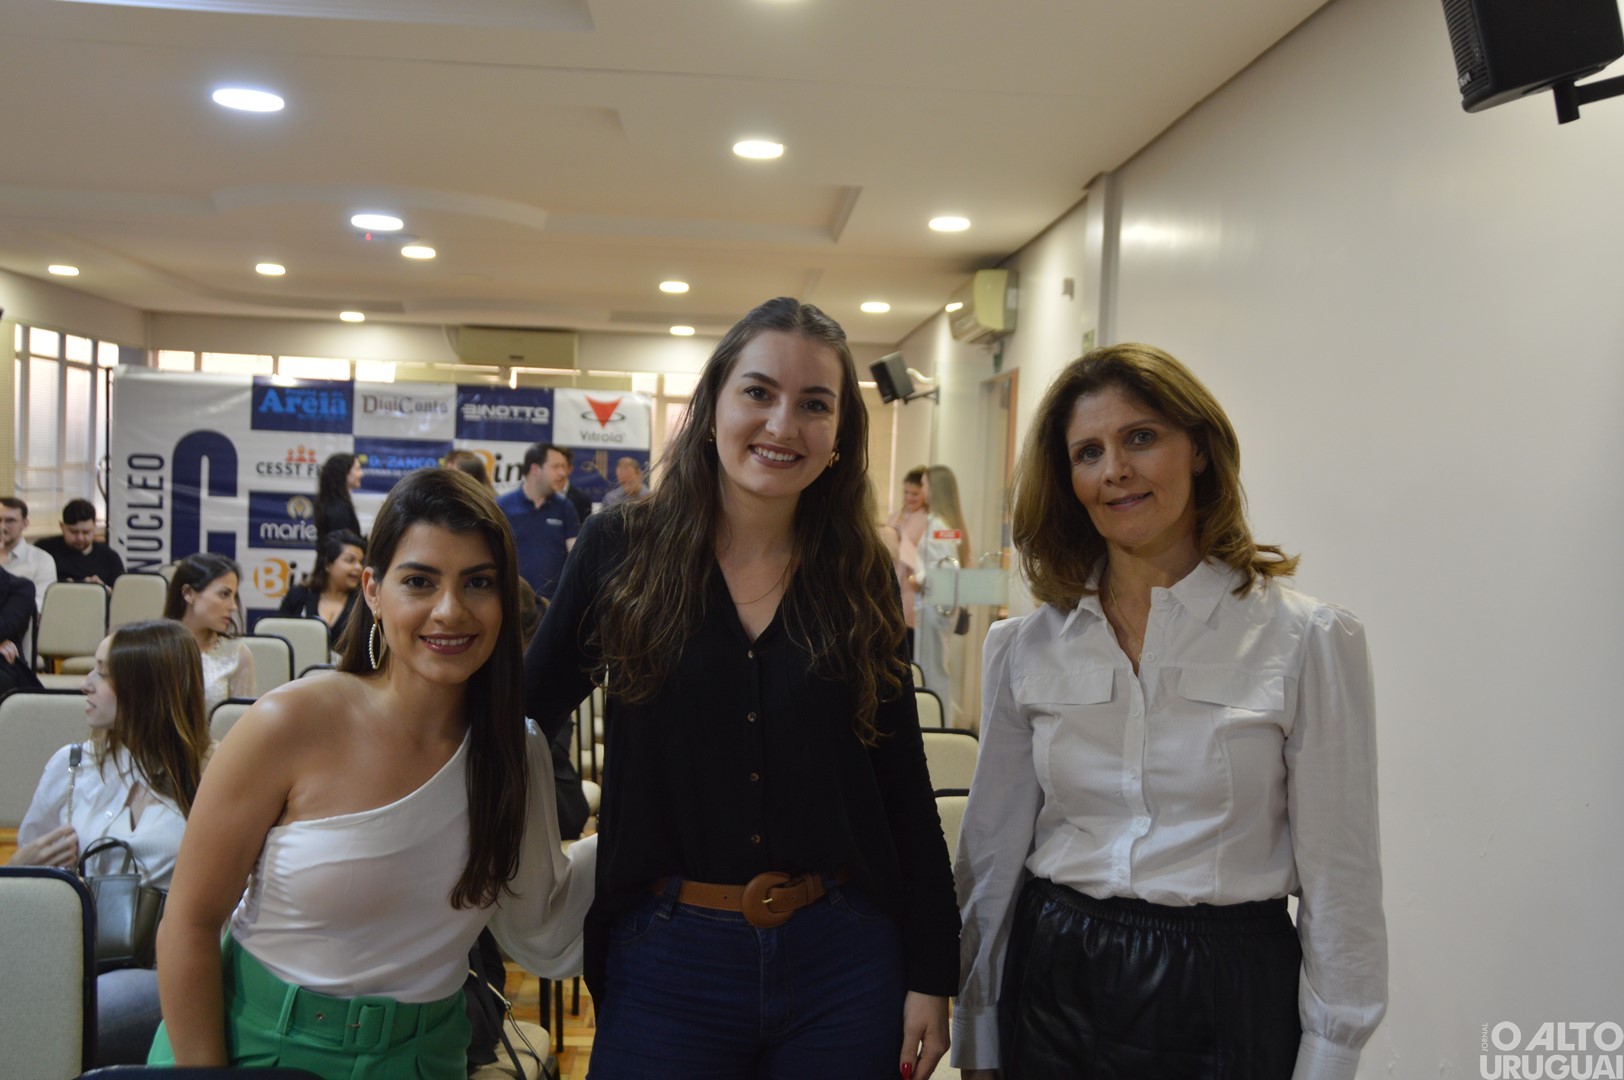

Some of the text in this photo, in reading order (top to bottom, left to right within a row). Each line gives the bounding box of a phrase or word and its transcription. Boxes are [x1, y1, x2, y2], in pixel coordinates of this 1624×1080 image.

[258, 388, 347, 416] Areia
[256, 461, 301, 476] CESST
[118, 452, 164, 574] NÚCLEO
